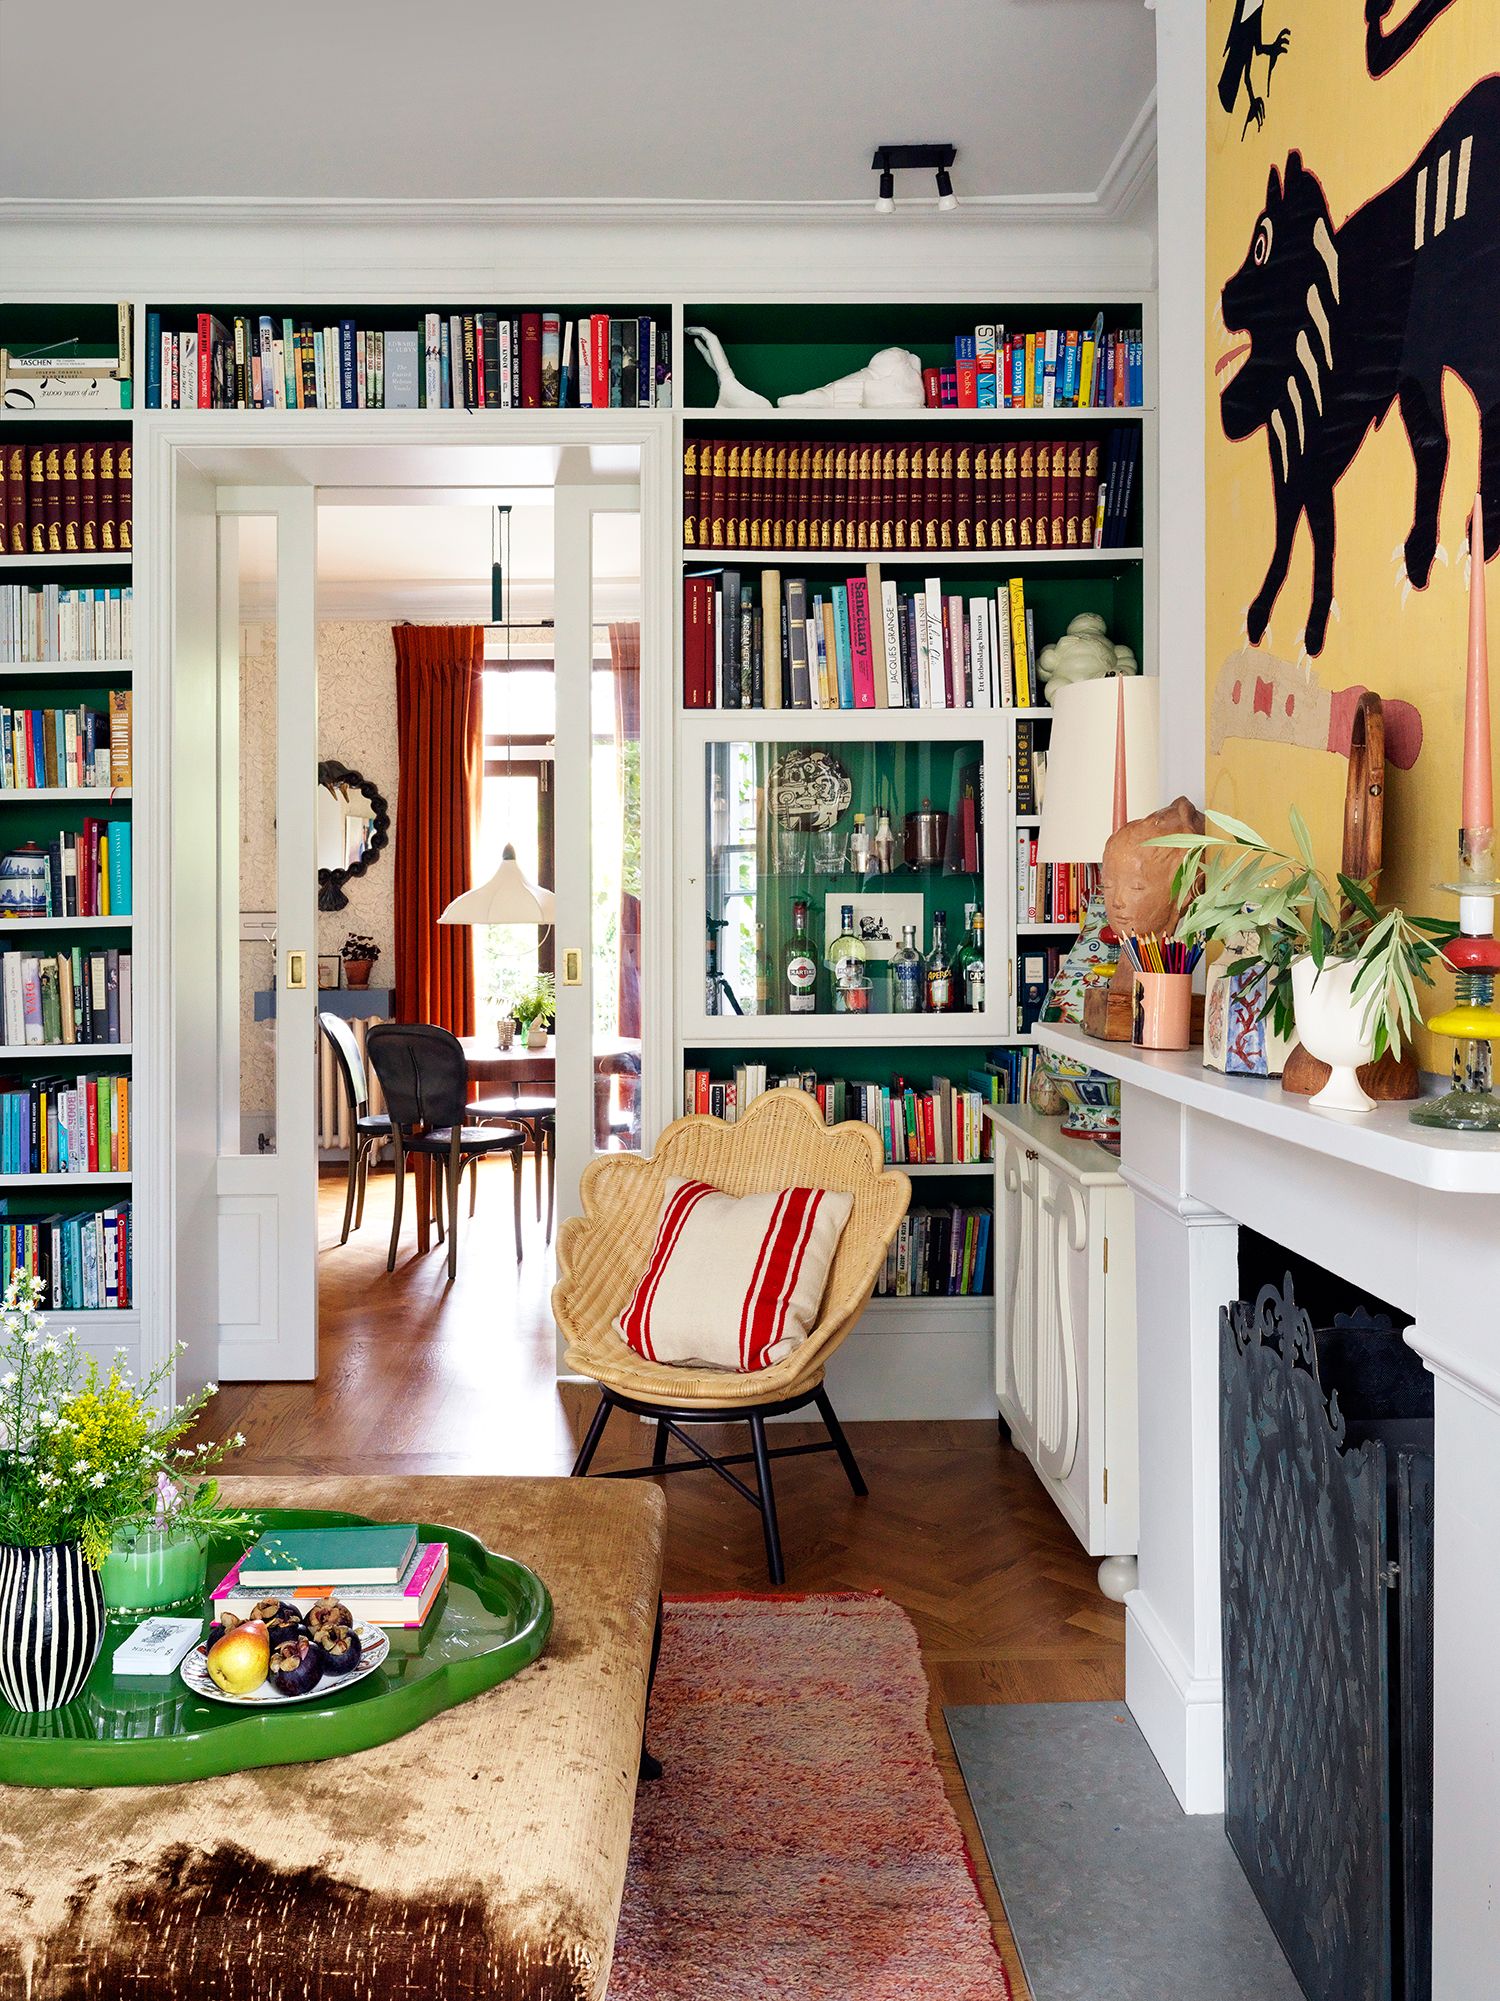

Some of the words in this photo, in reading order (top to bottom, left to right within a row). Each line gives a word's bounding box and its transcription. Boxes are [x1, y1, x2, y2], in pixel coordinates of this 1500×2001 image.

[464, 316, 473, 330] IAN
[465, 331, 474, 362] WRIGHT
[1014, 360, 1022, 393] Mexico
[1066, 348, 1074, 382] Argentina
[964, 370, 972, 395] Ordbok
[1011, 583, 1023, 608] May
[742, 614, 750, 645] ANSELM
[856, 581, 868, 657] Sanctuary
[886, 606, 896, 644] GRANGE
[976, 614, 984, 642] historia
[742, 646, 750, 670] KIEFER
[889, 646, 899, 684] JACQUES
[930, 648, 940, 665] Chic
[976, 642, 986, 680] fotbollslags
[112, 718, 128, 766] HAMILTON
[790, 968, 816, 976] MARTINI
[928, 970, 952, 981] APEROL
[25, 982, 37, 1014] DIVA
[67, 1095, 76, 1125] BOOK
